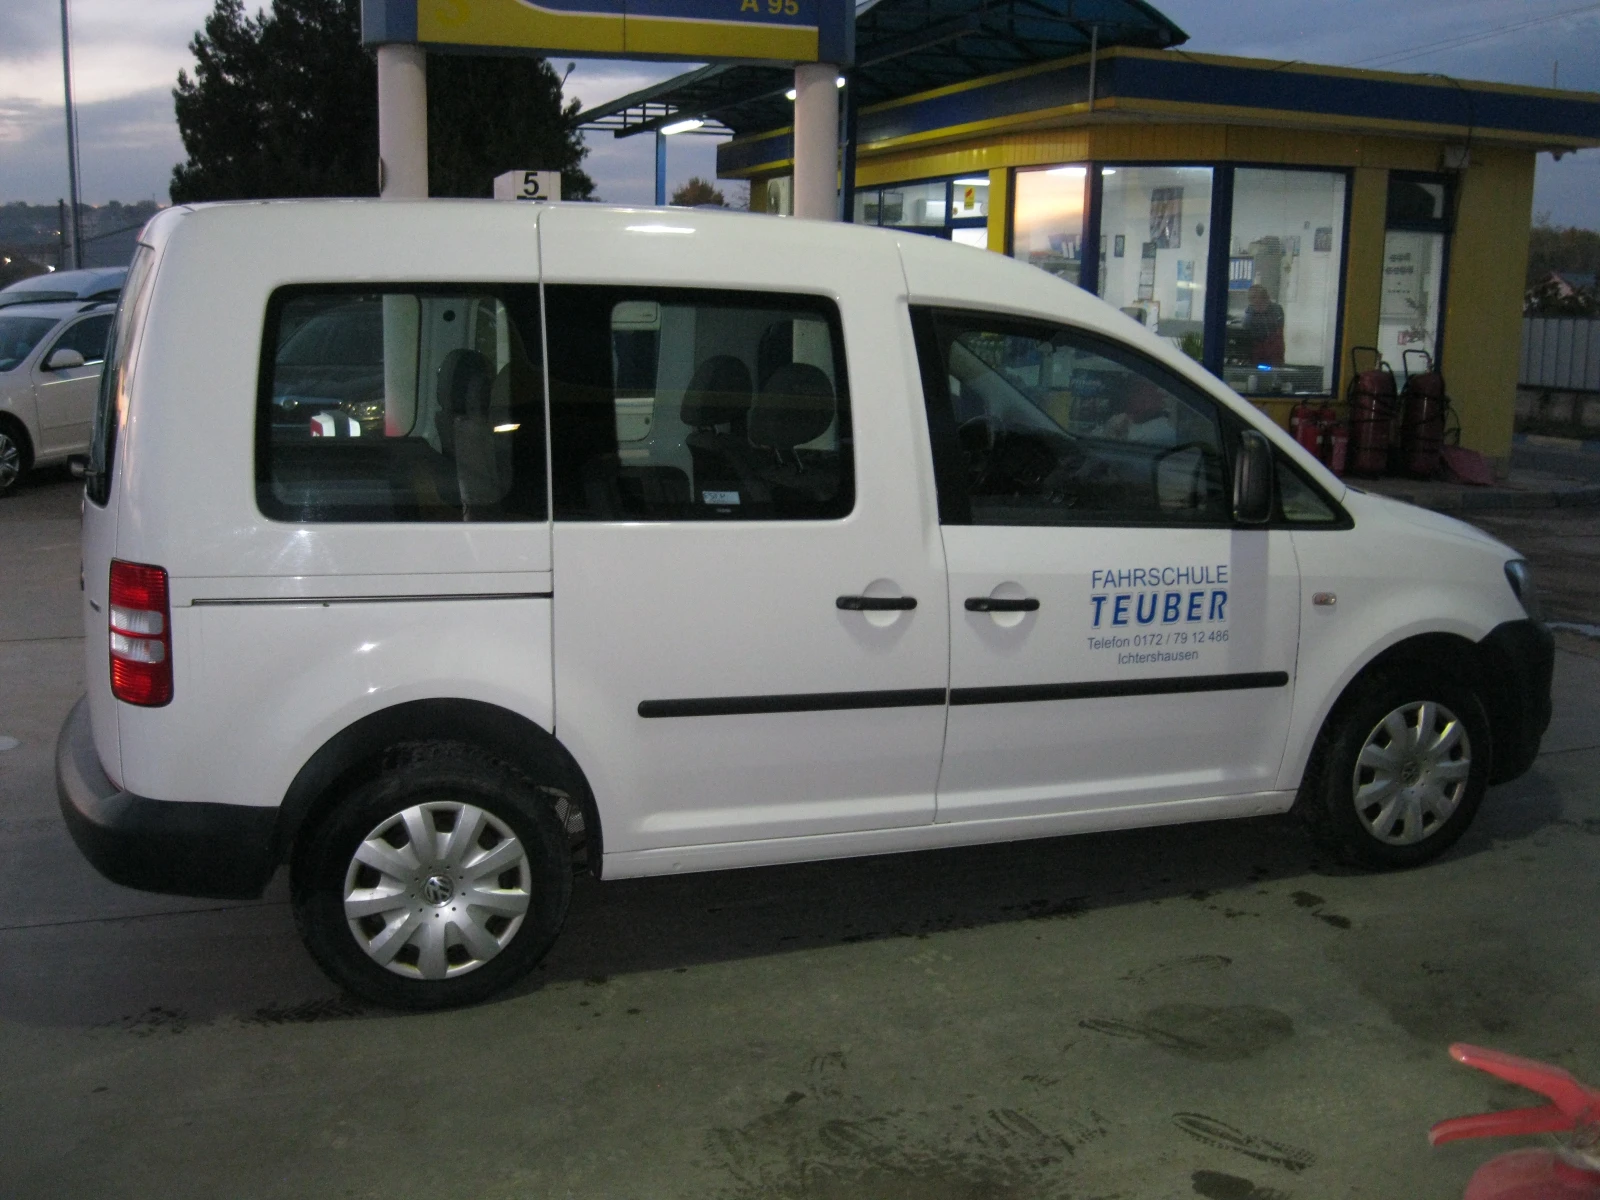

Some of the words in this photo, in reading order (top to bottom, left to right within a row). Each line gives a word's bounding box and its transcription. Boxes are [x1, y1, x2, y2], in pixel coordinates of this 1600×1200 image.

[740, 0, 760, 12] A
[767, 0, 799, 15] 95
[523, 172, 539, 196] 5
[1092, 565, 1228, 588] FAHRSCHULE
[1091, 589, 1228, 629] TEUBER
[1088, 637, 1130, 650] Telefon
[1133, 634, 1163, 647] 0172
[1173, 632, 1188, 645] 79
[1192, 631, 1205, 644] 12
[1208, 630, 1229, 643] 486
[1118, 650, 1199, 664] Ichtershausen
